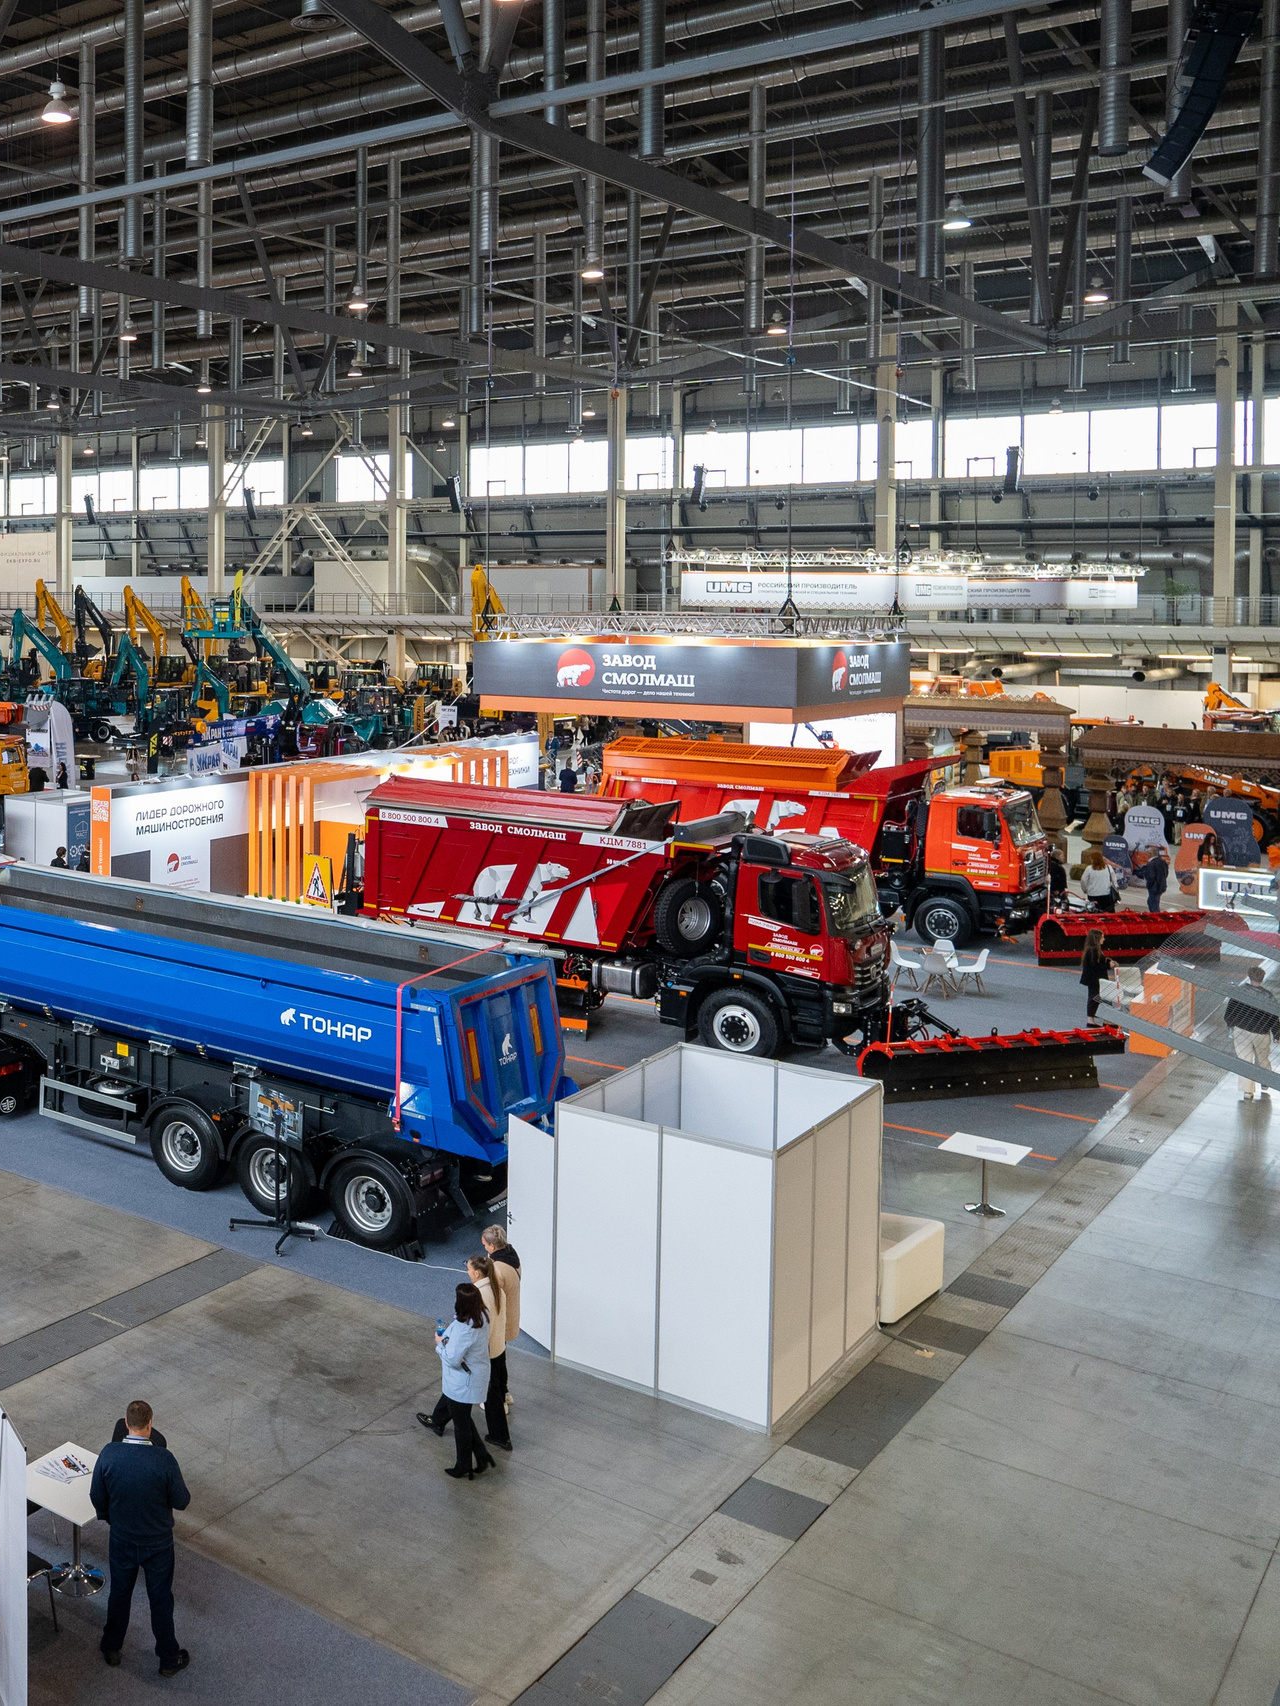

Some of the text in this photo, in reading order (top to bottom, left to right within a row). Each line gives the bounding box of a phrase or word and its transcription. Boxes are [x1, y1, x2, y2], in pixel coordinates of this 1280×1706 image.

[706, 581, 752, 593] UMG
[801, 582, 858, 590] ПРОИЗВОДИТЕЛЬ
[602, 654, 657, 670] ЗАВОД
[849, 654, 870, 669] ЗАВОД
[602, 672, 695, 688] СМОЛМАШ
[849, 671, 882, 686] СМОЛМАШ
[1204, 774, 1229, 786] UMG
[135, 799, 224, 822] ЛИДЕР ДОРОЖНОГО
[1209, 810, 1248, 820] UMG
[135, 813, 224, 836] МАШИНОСТРОЕНИЯ
[387, 812, 401, 821] 800
[403, 814, 416, 822] 500
[418, 815, 432, 824] 800
[434, 817, 439, 825] 4
[1129, 816, 1161, 826] UMG
[599, 836, 648, 850] КДМ 7881
[1184, 832, 1207, 840] UM
[1105, 841, 1127, 849] UMG
[299, 1012, 372, 1042] ТОНАР
[498, 1051, 518, 1067] ТОНАР
